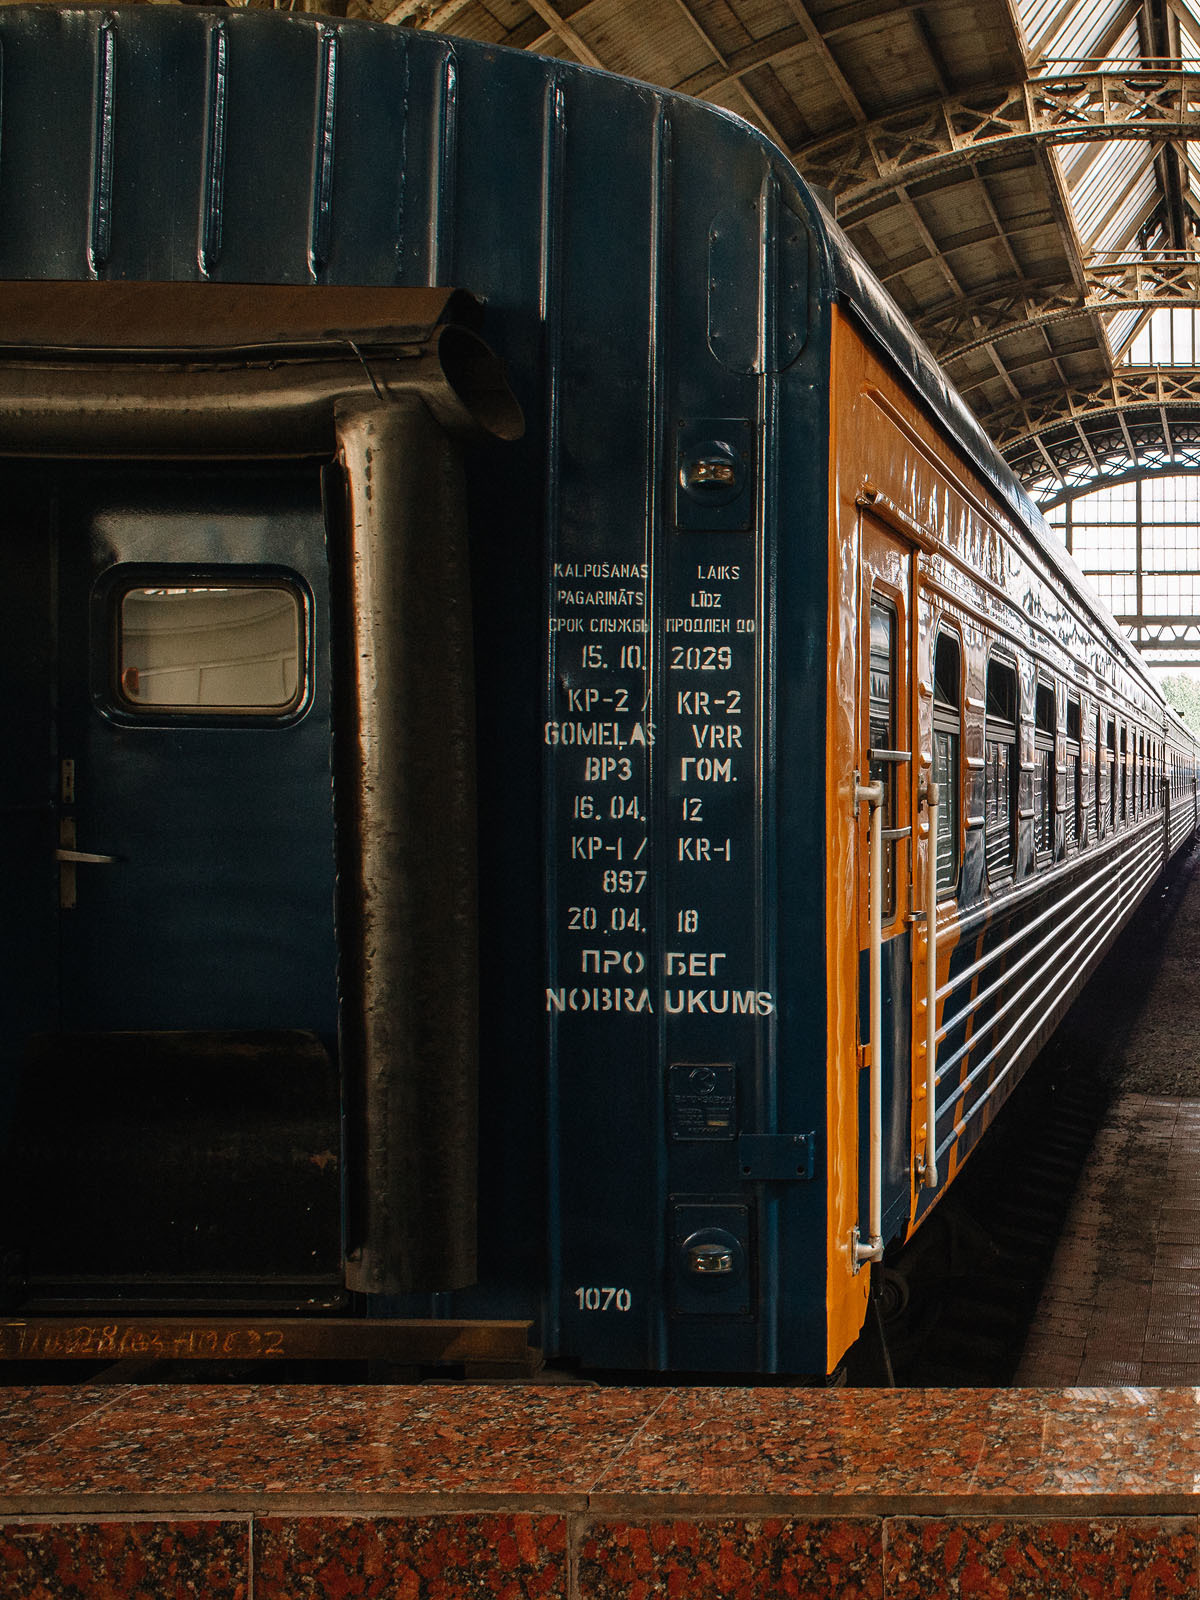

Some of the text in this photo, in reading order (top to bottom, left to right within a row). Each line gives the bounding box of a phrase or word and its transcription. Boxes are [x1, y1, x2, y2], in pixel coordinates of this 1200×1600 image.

[553, 562, 740, 580] KALPOŠANAS LAIKS
[557, 588, 722, 608] PAGARINĀTS LĪDZ
[549, 618, 584, 633] СРОК
[666, 618, 731, 633] ПРОДЛЕН
[736, 618, 756, 633] ДО
[670, 646, 732, 670] 2029
[677, 690, 742, 715] KR-2
[544, 722, 742, 751] GOMEĻAS VRR
[585, 757, 738, 782] ВРЗ ГОМ.
[682, 797, 703, 822] 12
[603, 870, 648, 894] 897
[678, 909, 699, 933] 18
[574, 1287, 632, 1312] 1070
